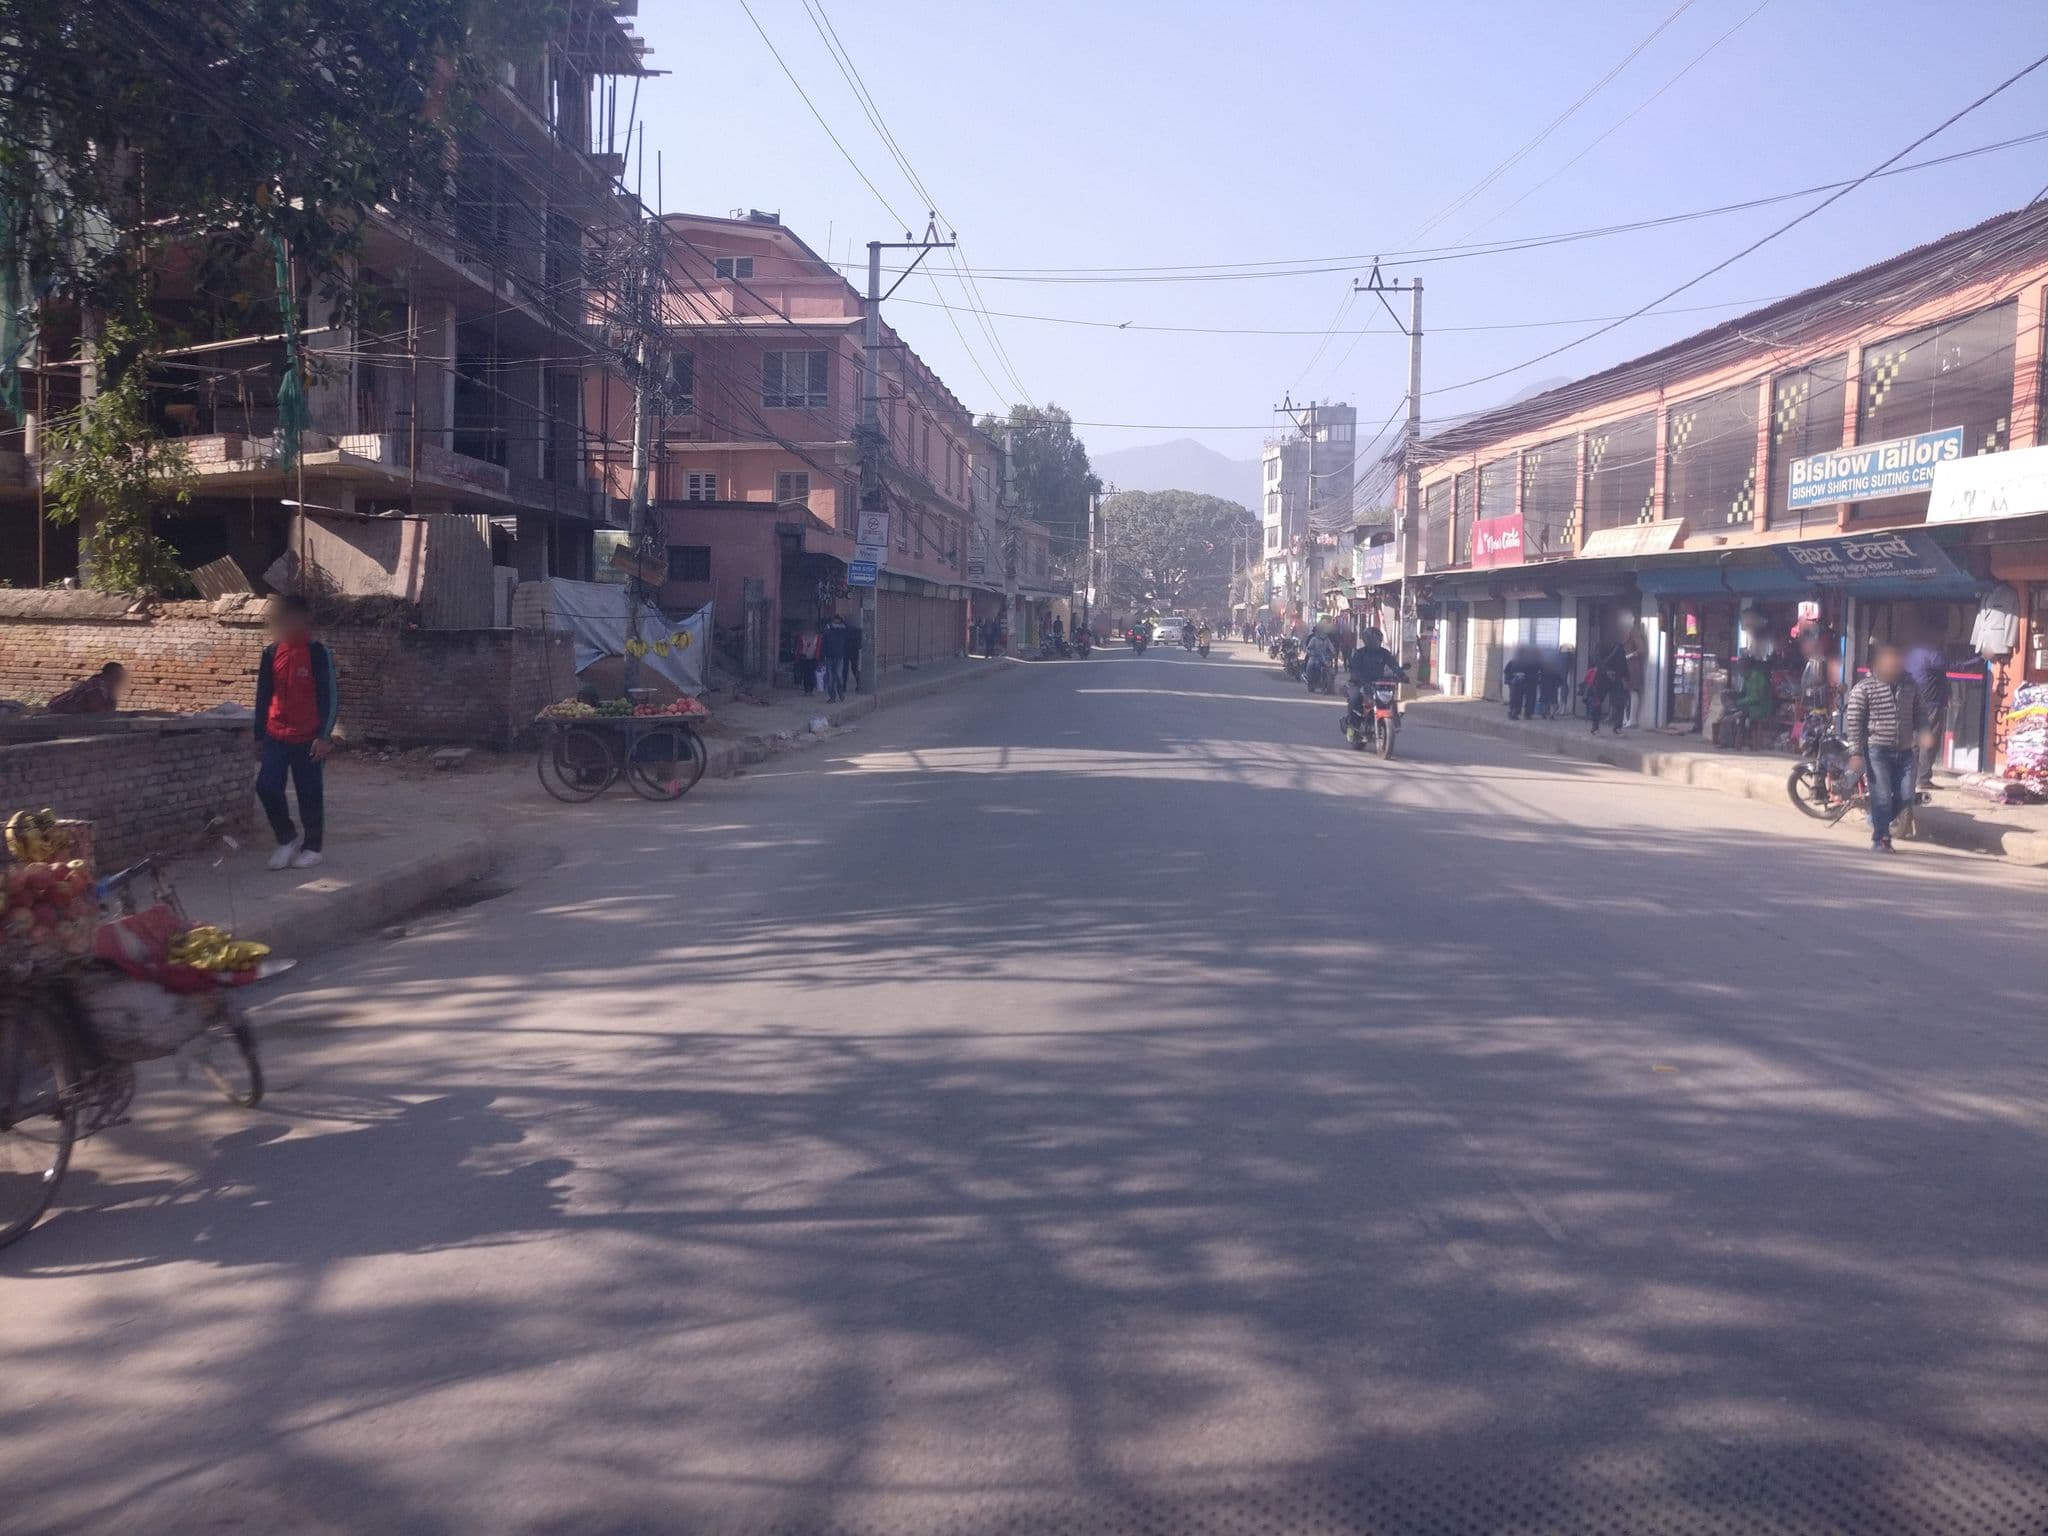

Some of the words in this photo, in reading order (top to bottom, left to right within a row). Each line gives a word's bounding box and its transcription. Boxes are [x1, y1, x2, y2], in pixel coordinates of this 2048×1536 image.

[1792, 453, 1871, 485] Bishow
[1878, 437, 1959, 471] Tailors
[1792, 483, 1826, 500] BISHOW
[1827, 476, 1869, 494] SHIRTING
[1871, 471, 1910, 487] SUITING
[1911, 467, 1936, 482] CEN
